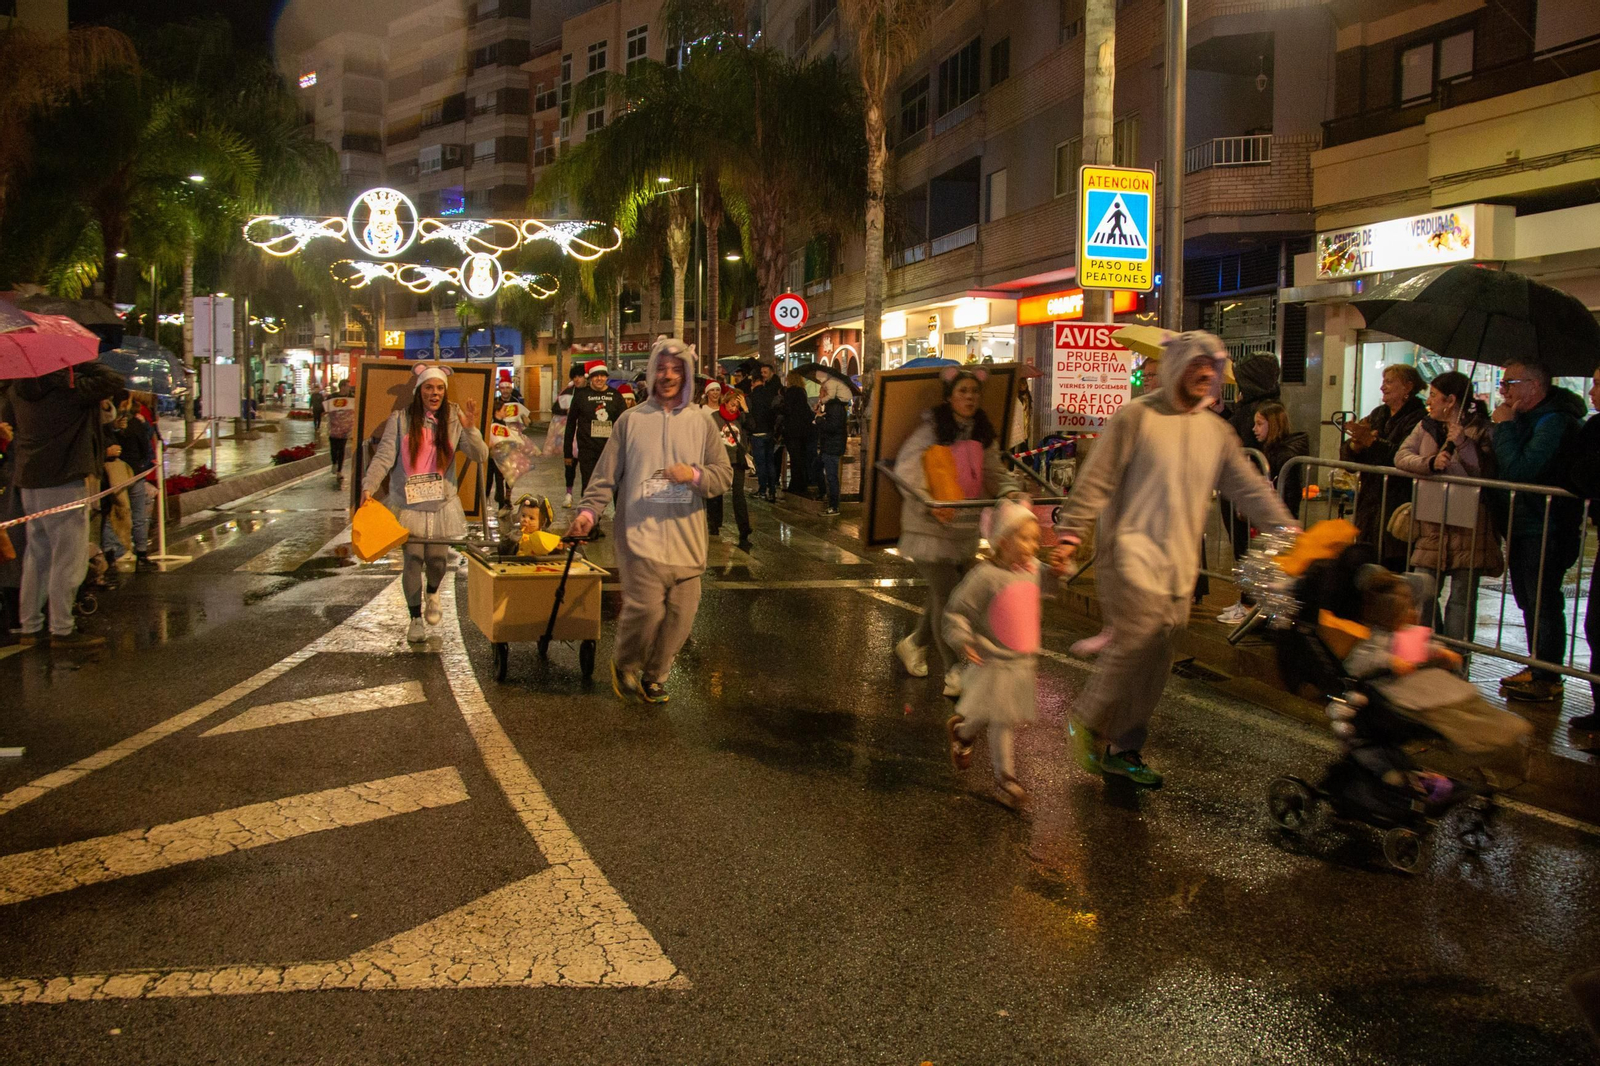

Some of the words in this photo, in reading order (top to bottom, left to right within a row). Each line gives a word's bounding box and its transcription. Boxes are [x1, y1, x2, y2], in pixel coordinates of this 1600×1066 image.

[1088, 175, 1149, 190] ATENCIÓN
[1362, 229, 1372, 246] DE
[1411, 213, 1455, 237] VERDURAS
[1091, 260, 1122, 270] PASO
[1128, 262, 1143, 272] DE
[1086, 272, 1147, 284] PEATONES
[779, 306, 800, 319] 30
[1067, 351, 1118, 362] PRUEBA
[1057, 362, 1127, 373] DEPORTIVA
[1060, 391, 1123, 405] TRÁFICO
[1058, 416, 1086, 426] 17:00
[1088, 418, 1095, 427] A
